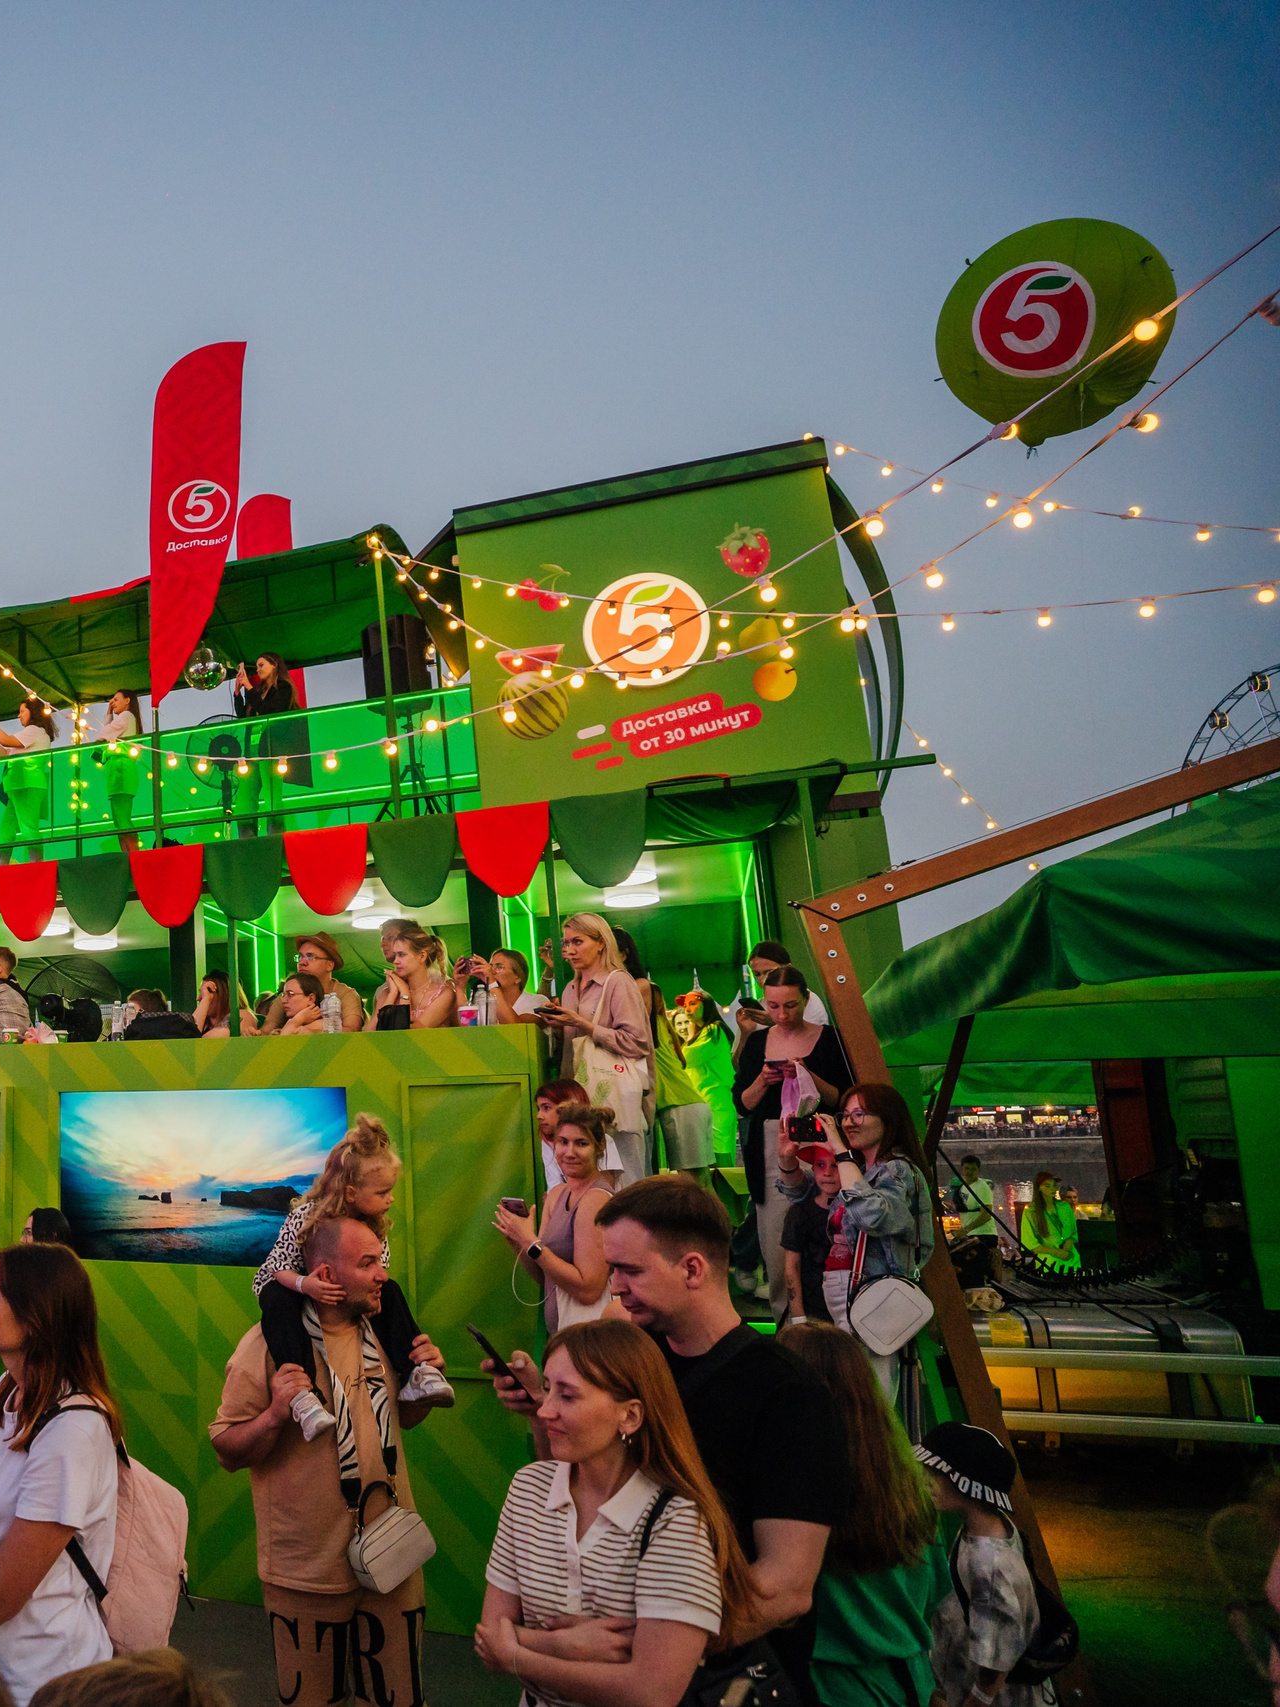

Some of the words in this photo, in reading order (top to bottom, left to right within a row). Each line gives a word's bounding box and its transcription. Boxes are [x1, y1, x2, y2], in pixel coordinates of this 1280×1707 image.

[1000, 271, 1073, 354] 5
[184, 484, 218, 523] 5
[166, 534, 228, 553] Доставка
[618, 581, 676, 665] 5
[621, 700, 712, 738] Доставка
[639, 736, 661, 751] от
[665, 726, 686, 745] 30
[690, 710, 751, 738] минут
